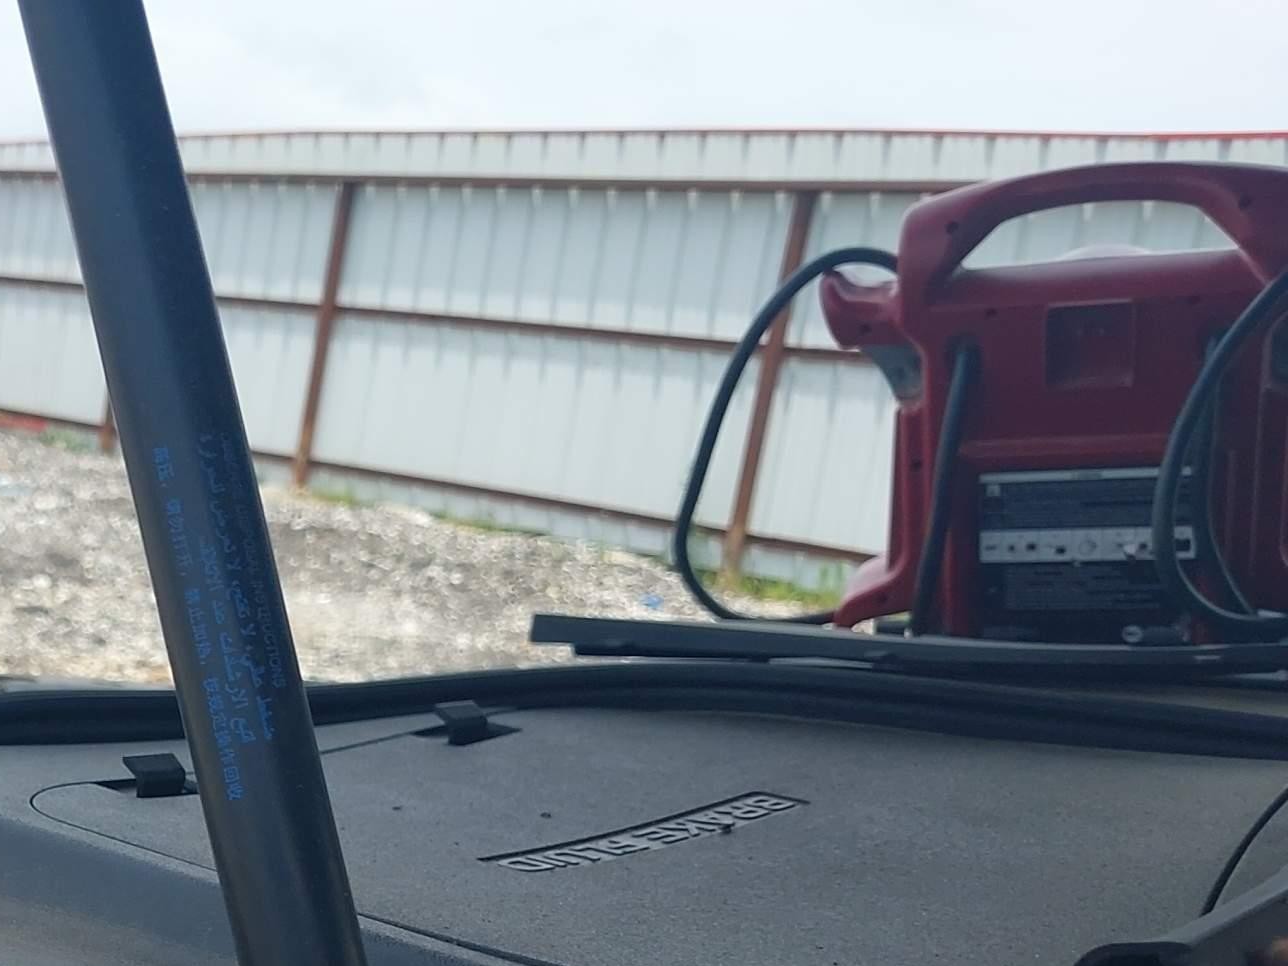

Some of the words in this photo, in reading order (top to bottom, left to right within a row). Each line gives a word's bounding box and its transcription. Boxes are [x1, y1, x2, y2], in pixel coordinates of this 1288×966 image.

[251, 579, 285, 688] INSTRUCTIONS
[633, 795, 799, 845] BRAKE
[497, 838, 650, 873] FLUID
